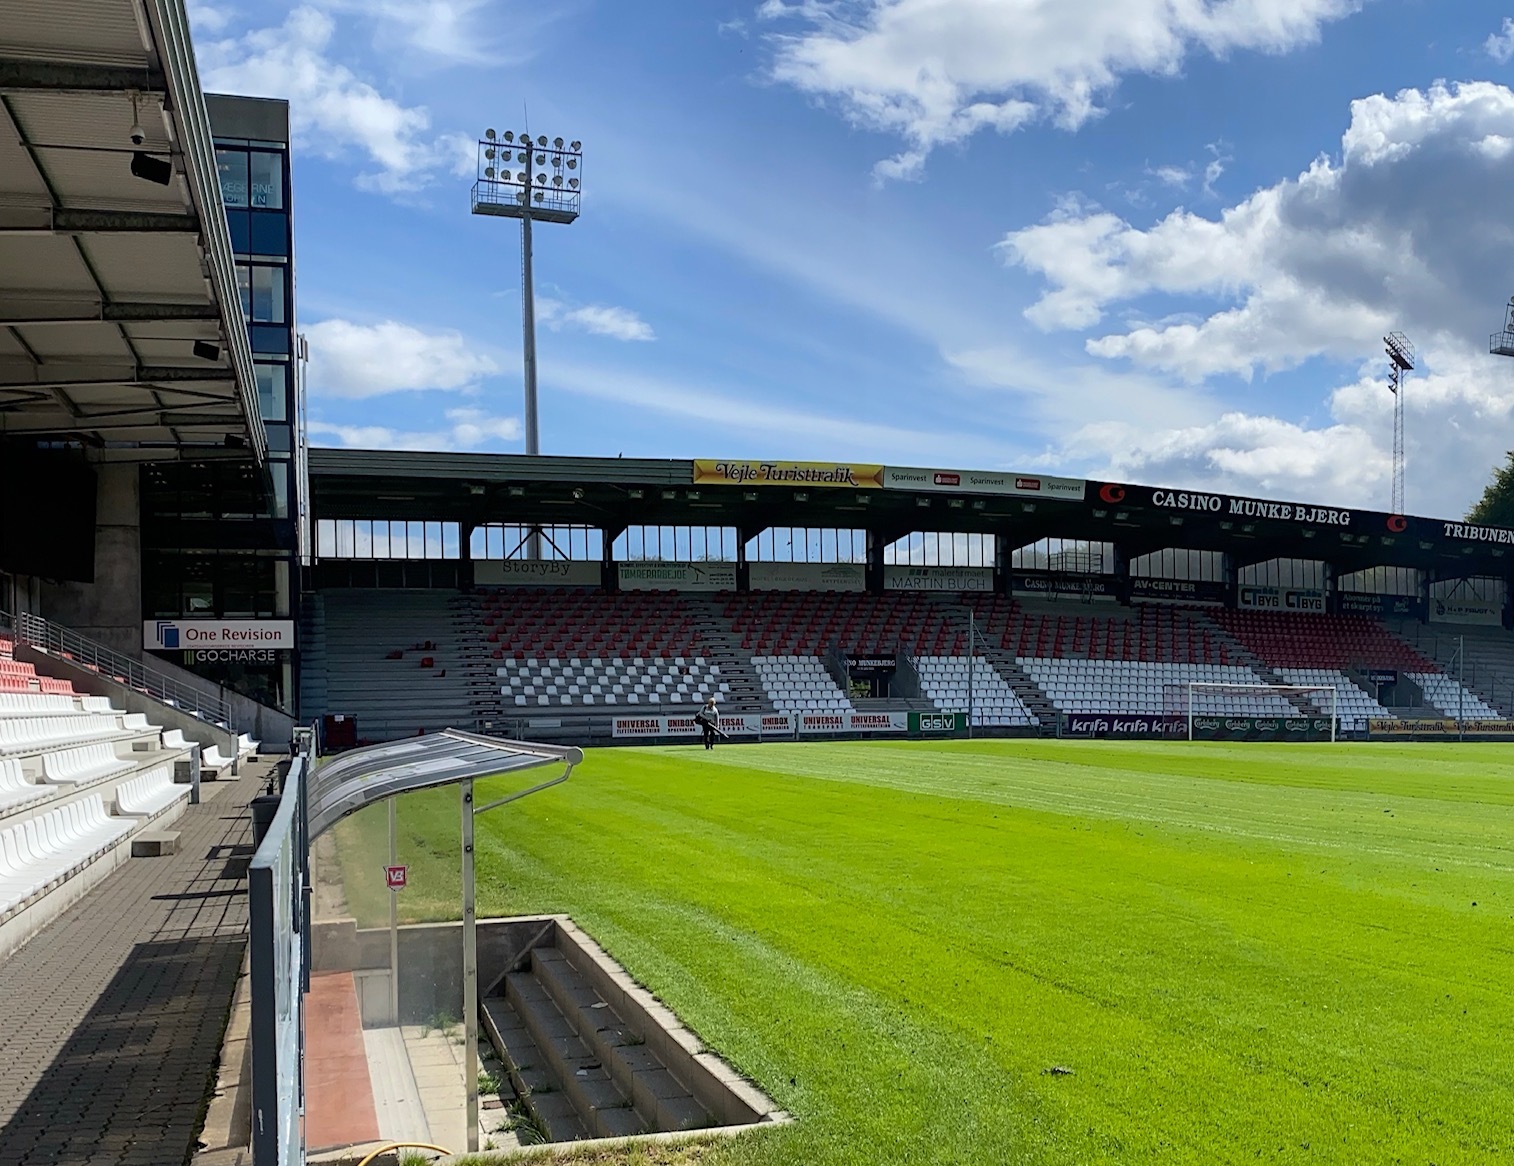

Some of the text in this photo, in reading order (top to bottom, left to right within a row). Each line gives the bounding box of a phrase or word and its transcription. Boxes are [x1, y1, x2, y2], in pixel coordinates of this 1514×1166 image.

[715, 462, 860, 487] Vejle Turisttrafik
[891, 472, 927, 484] Sparinvest
[970, 476, 1004, 487] Sparinvest
[1047, 481, 1081, 493] Sparinvest
[1152, 489, 1223, 514] CASINO
[502, 560, 572, 575] StoryBy
[892, 577, 986, 590] MARTIN BUCH
[186, 628, 282, 641] One Revision
[616, 719, 661, 729] UNIVERSAL
[667, 719, 695, 728] UNIBOX
[762, 717, 789, 725] UNIBOX
[803, 716, 844, 725] UNIVERSAL
[850, 714, 892, 724] UNIVERSAL
[921, 716, 954, 729] GSV
[1071, 718, 1188, 734] krifa krifa krifa
